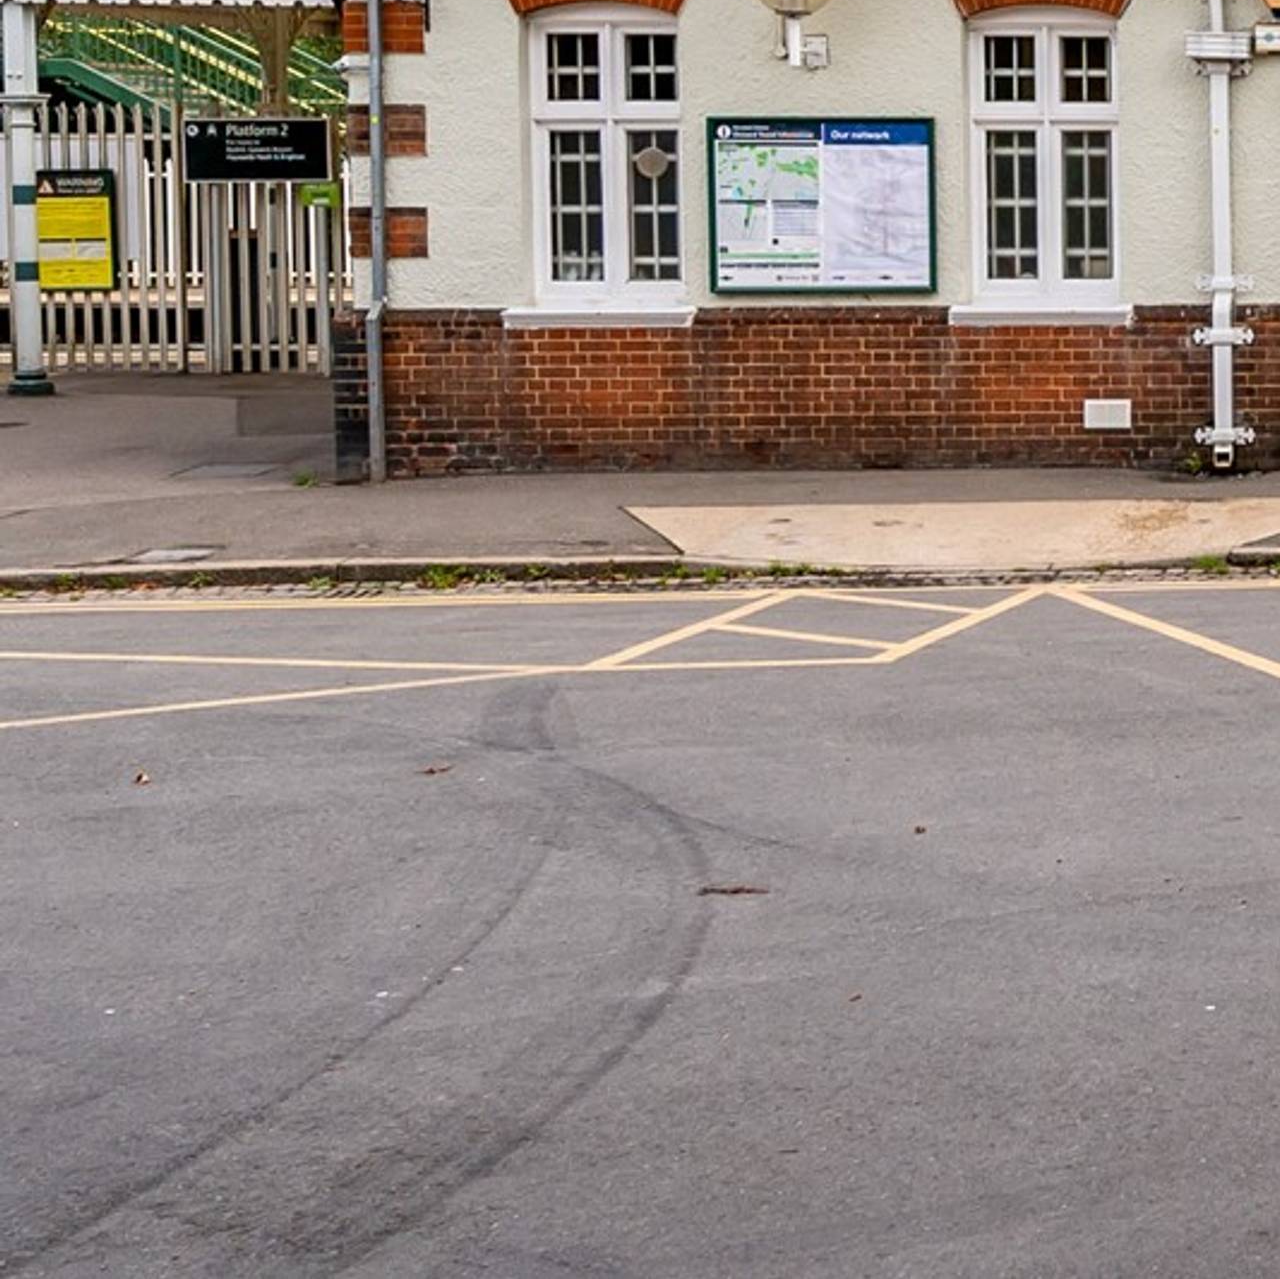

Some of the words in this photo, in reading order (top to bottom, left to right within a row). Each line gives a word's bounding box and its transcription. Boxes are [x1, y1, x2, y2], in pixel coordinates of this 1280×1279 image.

[225, 123, 278, 137] Platform
[280, 123, 289, 137] 2
[830, 130, 849, 140] Our
[851, 130, 890, 140] network
[56, 177, 104, 187] WARNING
